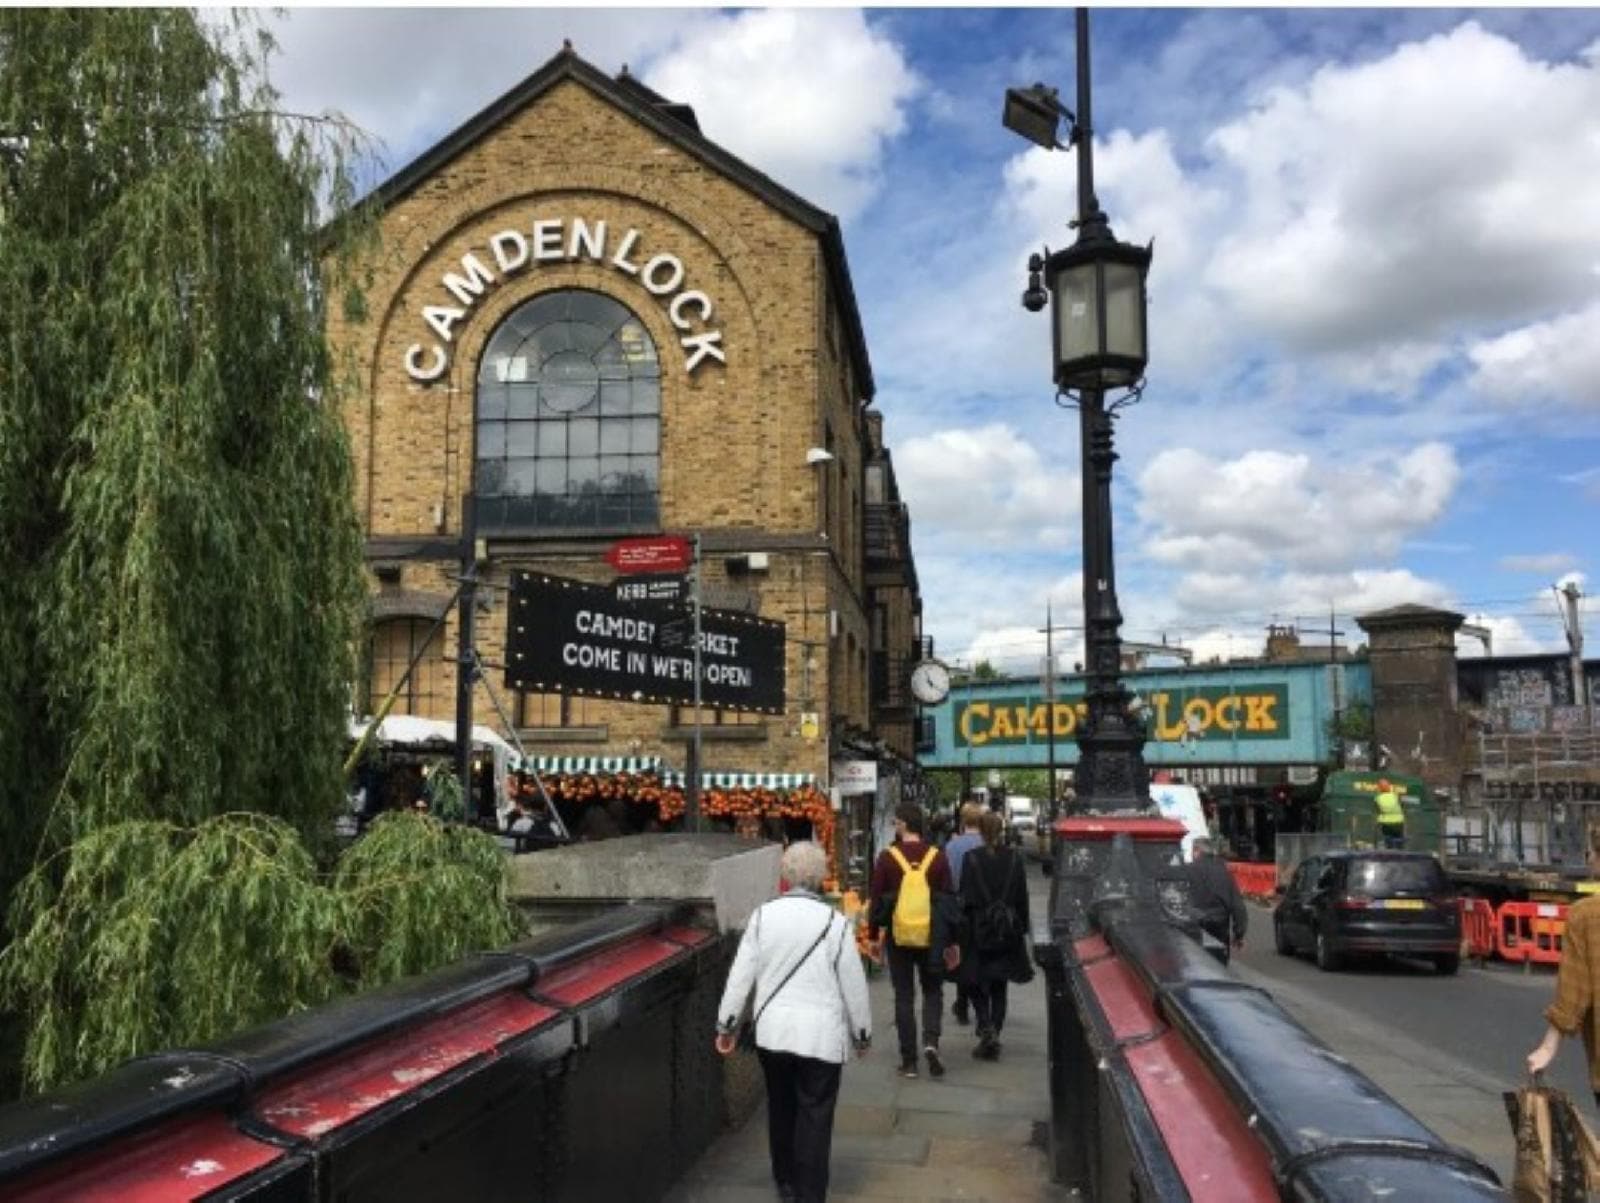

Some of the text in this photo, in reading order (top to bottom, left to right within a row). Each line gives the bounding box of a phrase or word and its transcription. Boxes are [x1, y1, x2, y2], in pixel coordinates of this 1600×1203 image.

[405, 217, 725, 382] CAMDEN LOCK
[563, 642, 621, 671] COME
[627, 652, 647, 674] IN
[651, 655, 696, 681] WE'R
[961, 693, 1277, 744] CAMD LOCK
